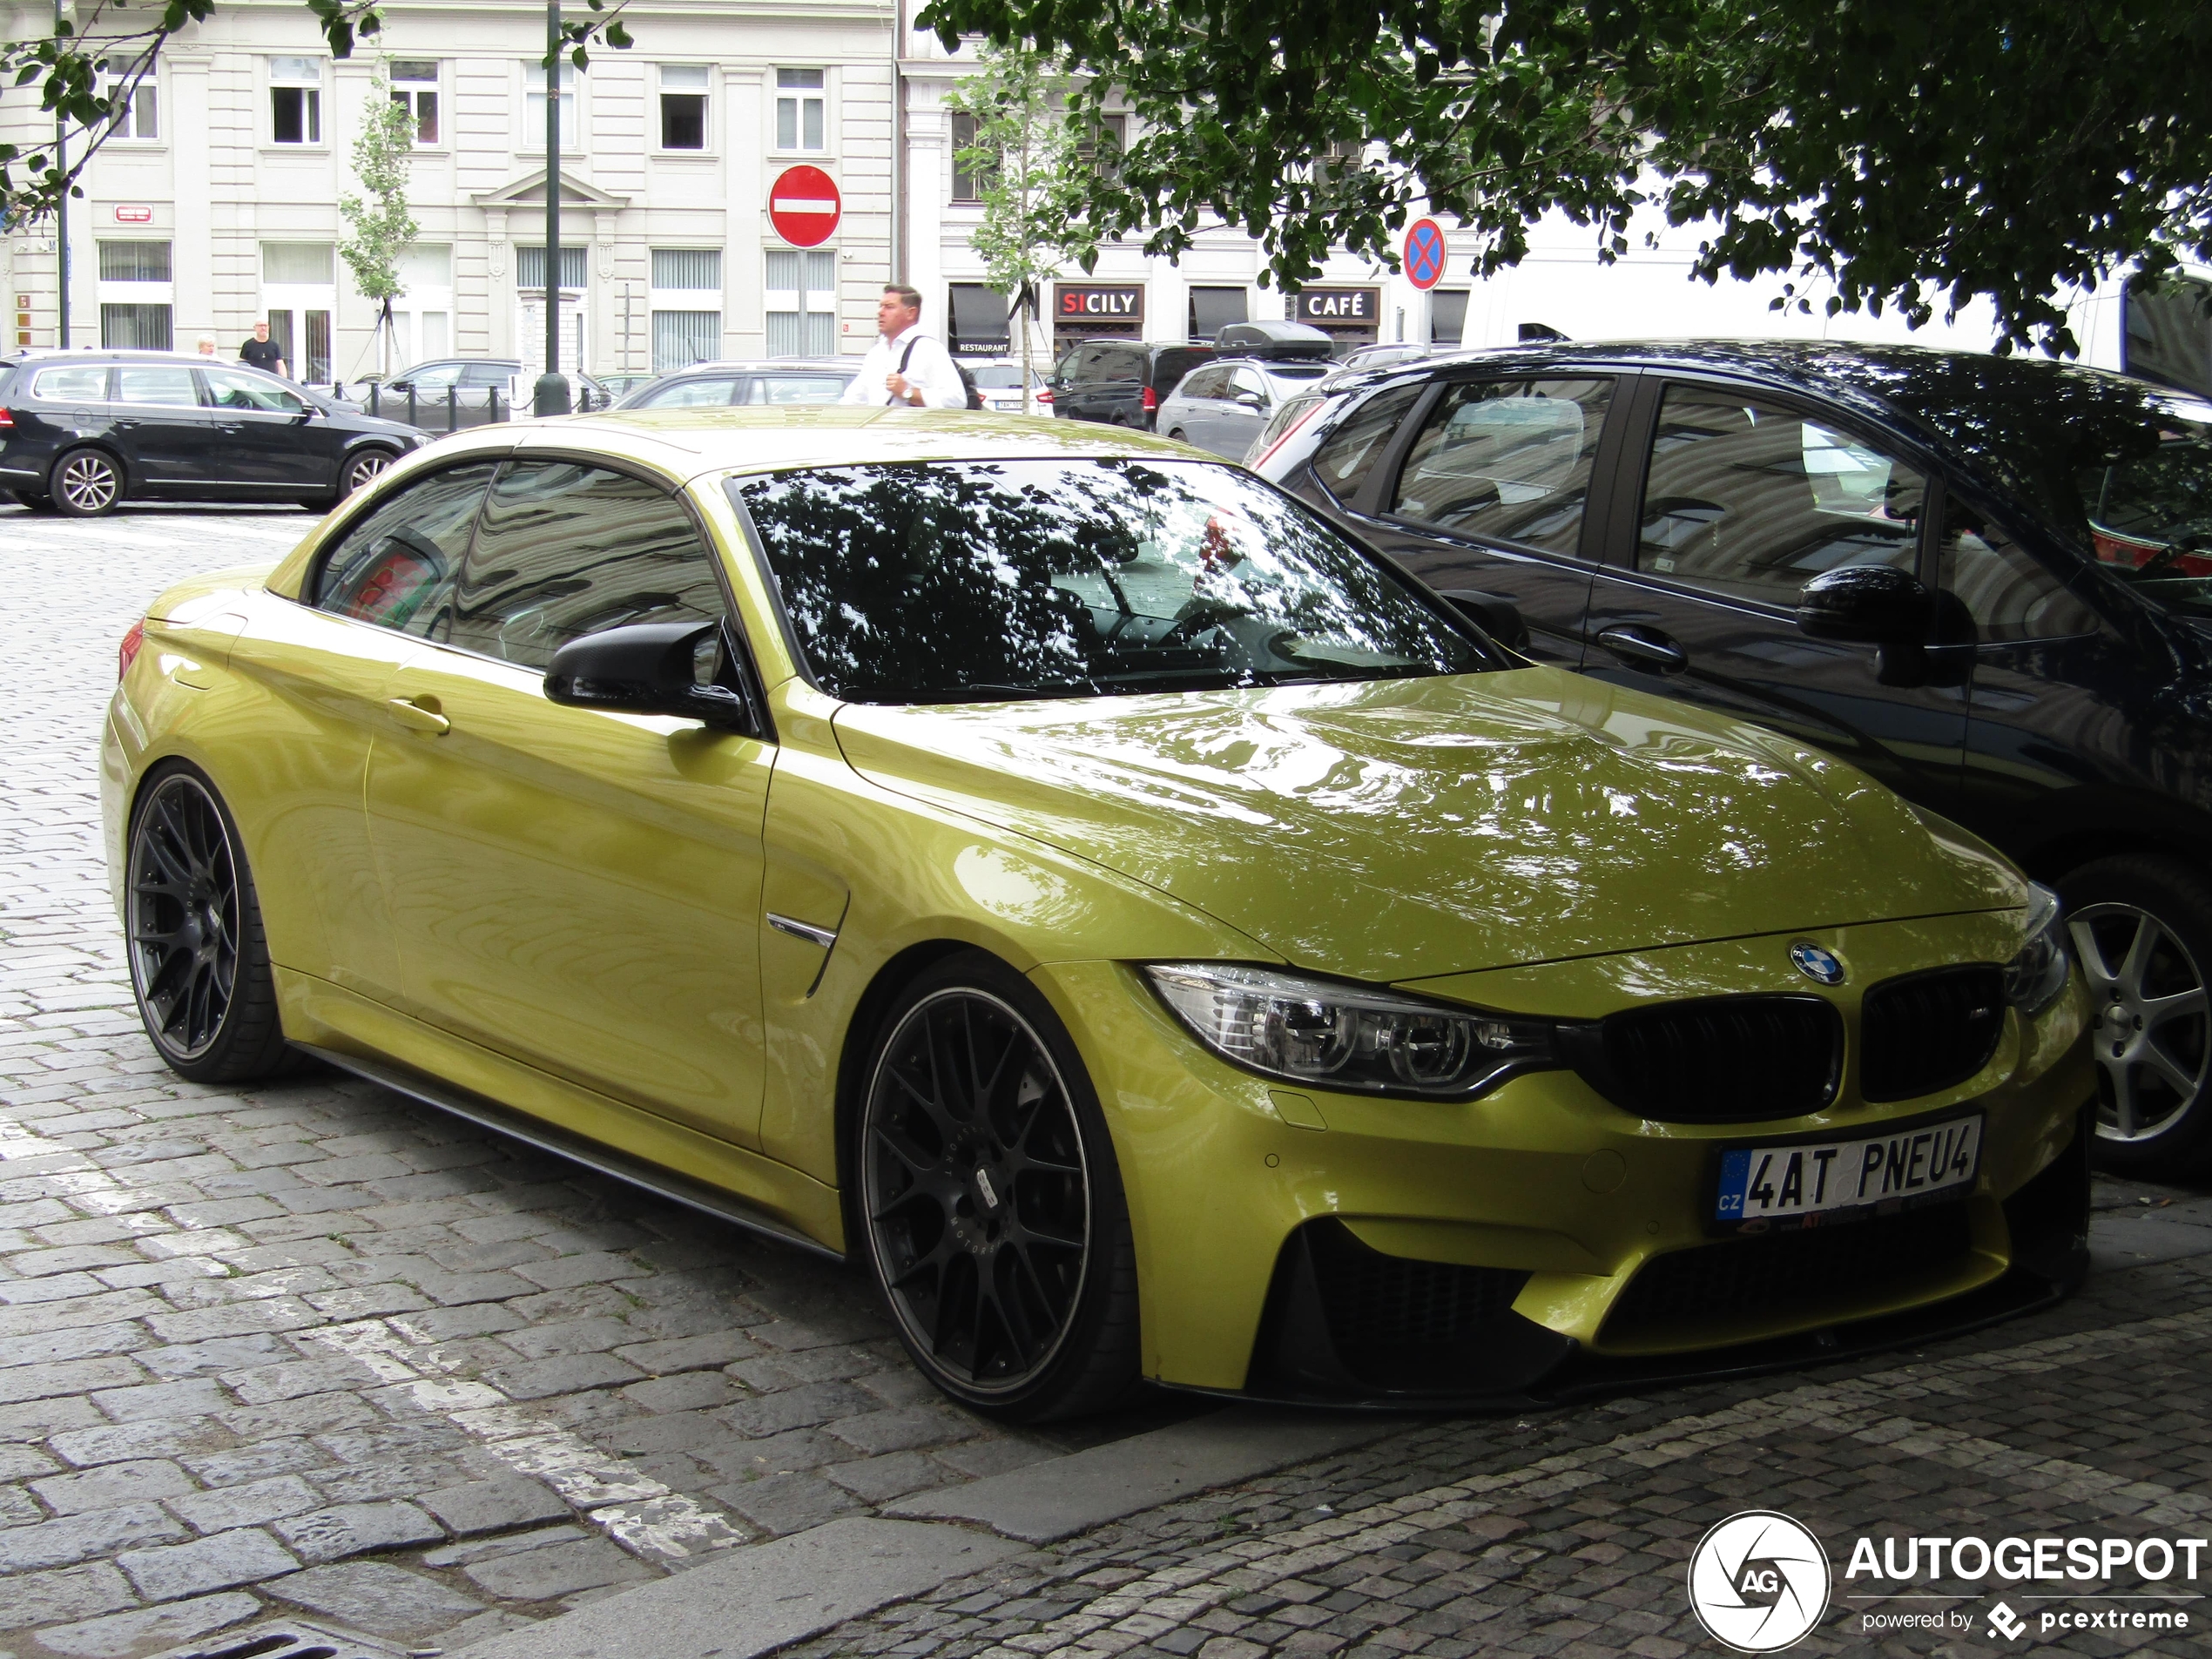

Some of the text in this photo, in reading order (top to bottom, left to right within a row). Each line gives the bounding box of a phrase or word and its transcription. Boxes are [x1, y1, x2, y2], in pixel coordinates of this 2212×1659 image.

[1063, 293, 1135, 313] SICILY
[1309, 293, 1364, 316] CAFÉ
[960, 343, 1008, 352] RESTAURANT
[1748, 1124, 1970, 1209] 4AT PNEU4
[1719, 1194, 1741, 1211] CZ
